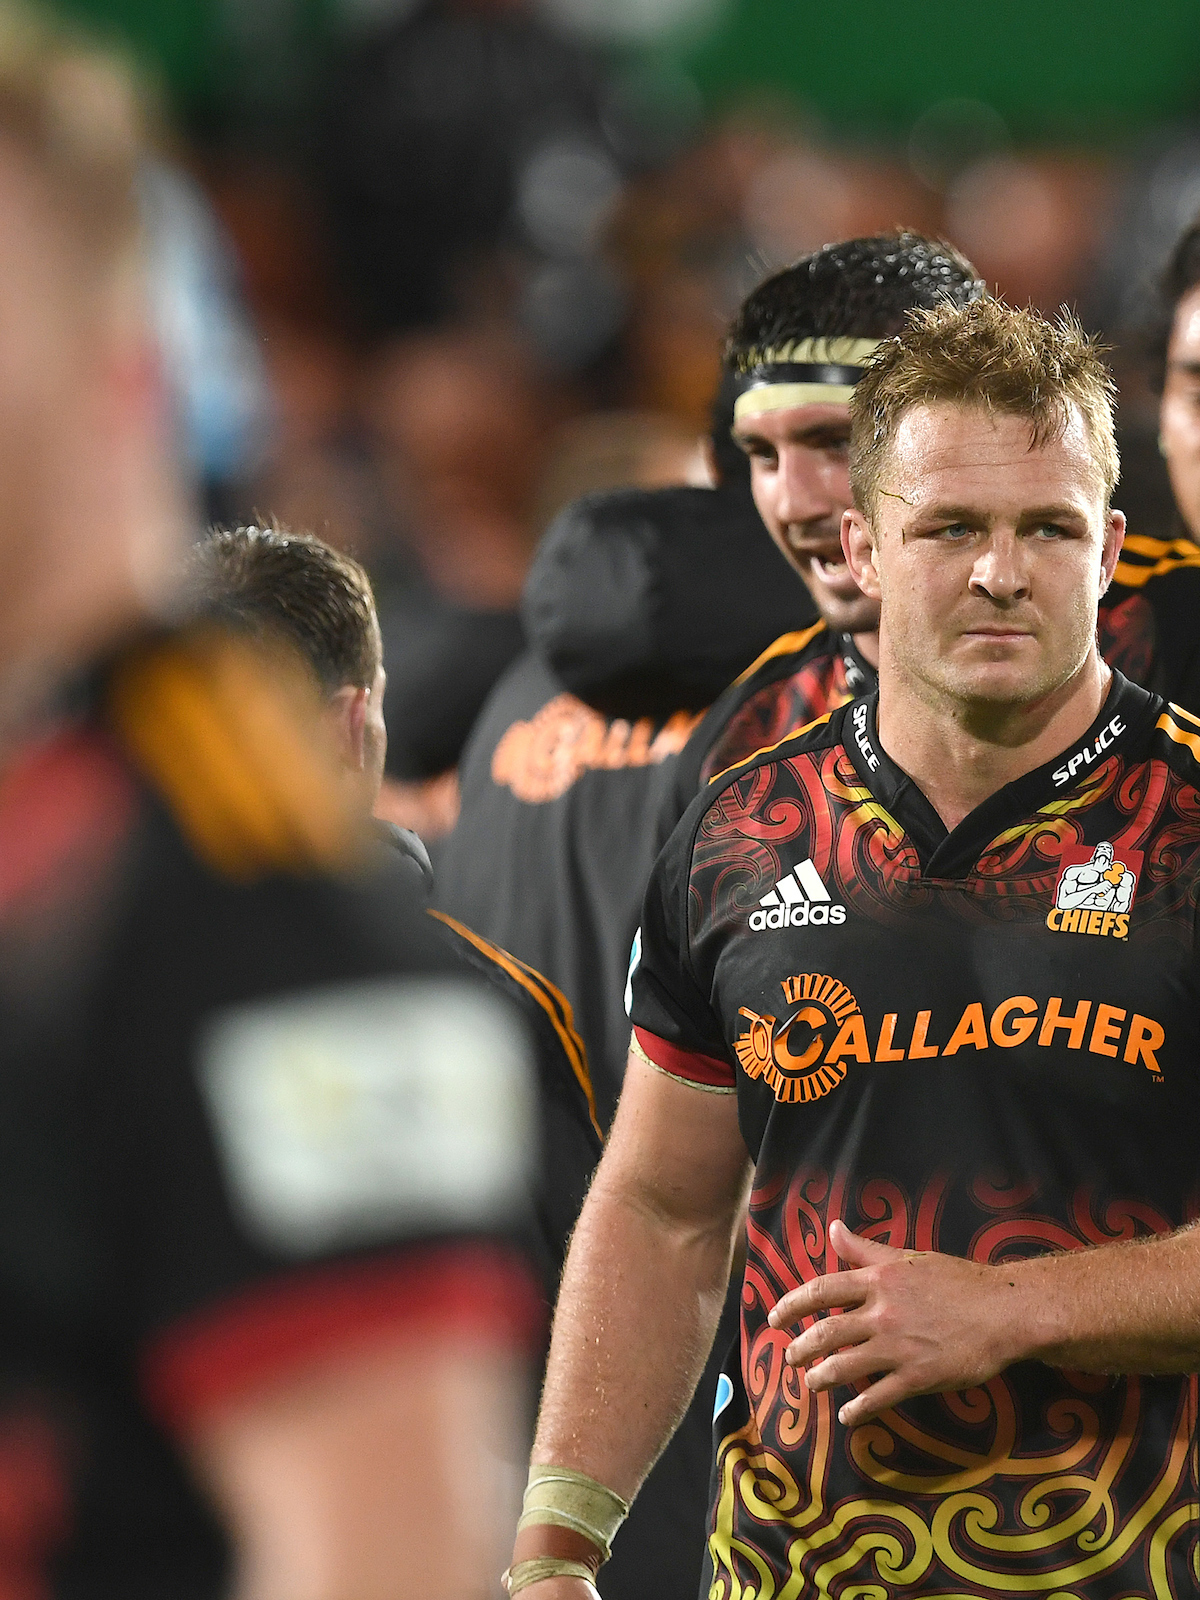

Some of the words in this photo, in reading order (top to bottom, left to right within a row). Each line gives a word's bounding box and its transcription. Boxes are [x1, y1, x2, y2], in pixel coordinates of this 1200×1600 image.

[748, 900, 846, 932] adidas
[1047, 908, 1130, 938] CHIEFS
[1152, 1074, 1165, 1083] TM
